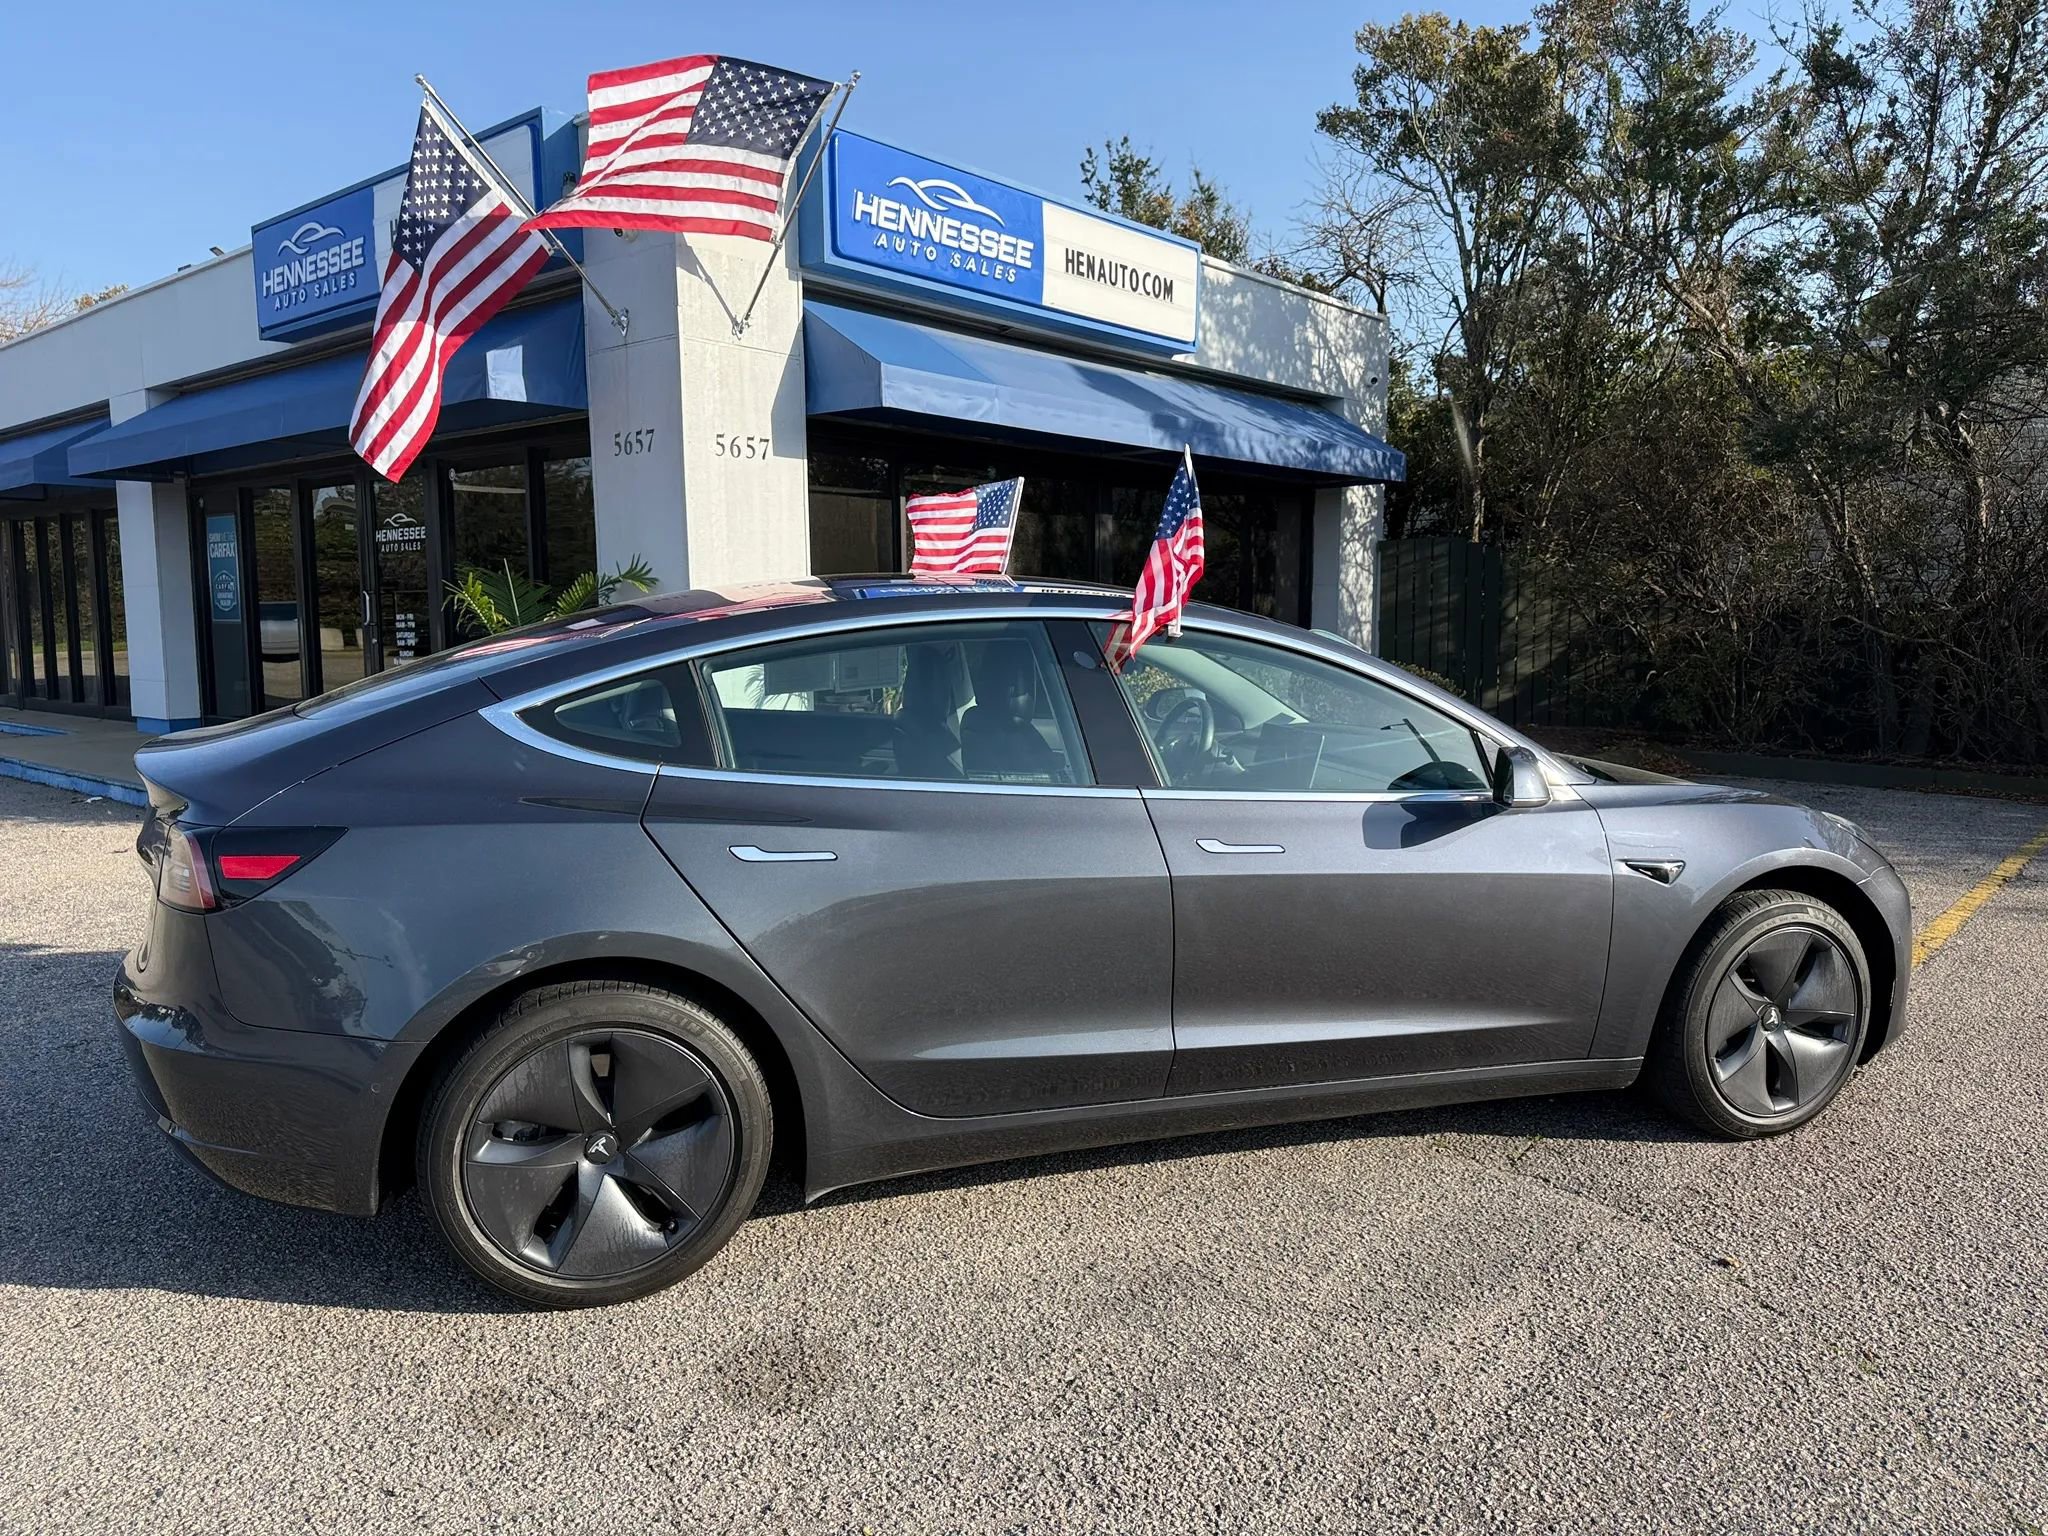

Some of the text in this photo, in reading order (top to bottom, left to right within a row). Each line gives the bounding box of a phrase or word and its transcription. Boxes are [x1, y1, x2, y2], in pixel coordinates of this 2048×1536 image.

[854, 190, 1035, 269] HENNESSEE
[262, 236, 365, 298] HENNESSEE
[875, 233, 1016, 282] AUTO SALES
[274, 272, 356, 311] AUTO SALES
[1065, 247, 1174, 303] HENAUTO.COM
[614, 428, 655, 457] 5657
[715, 433, 770, 461] 5657
[209, 543, 235, 558] CARFAX
[375, 526, 426, 542] HENNESSEE
[381, 541, 421, 553] AUTO SALES
